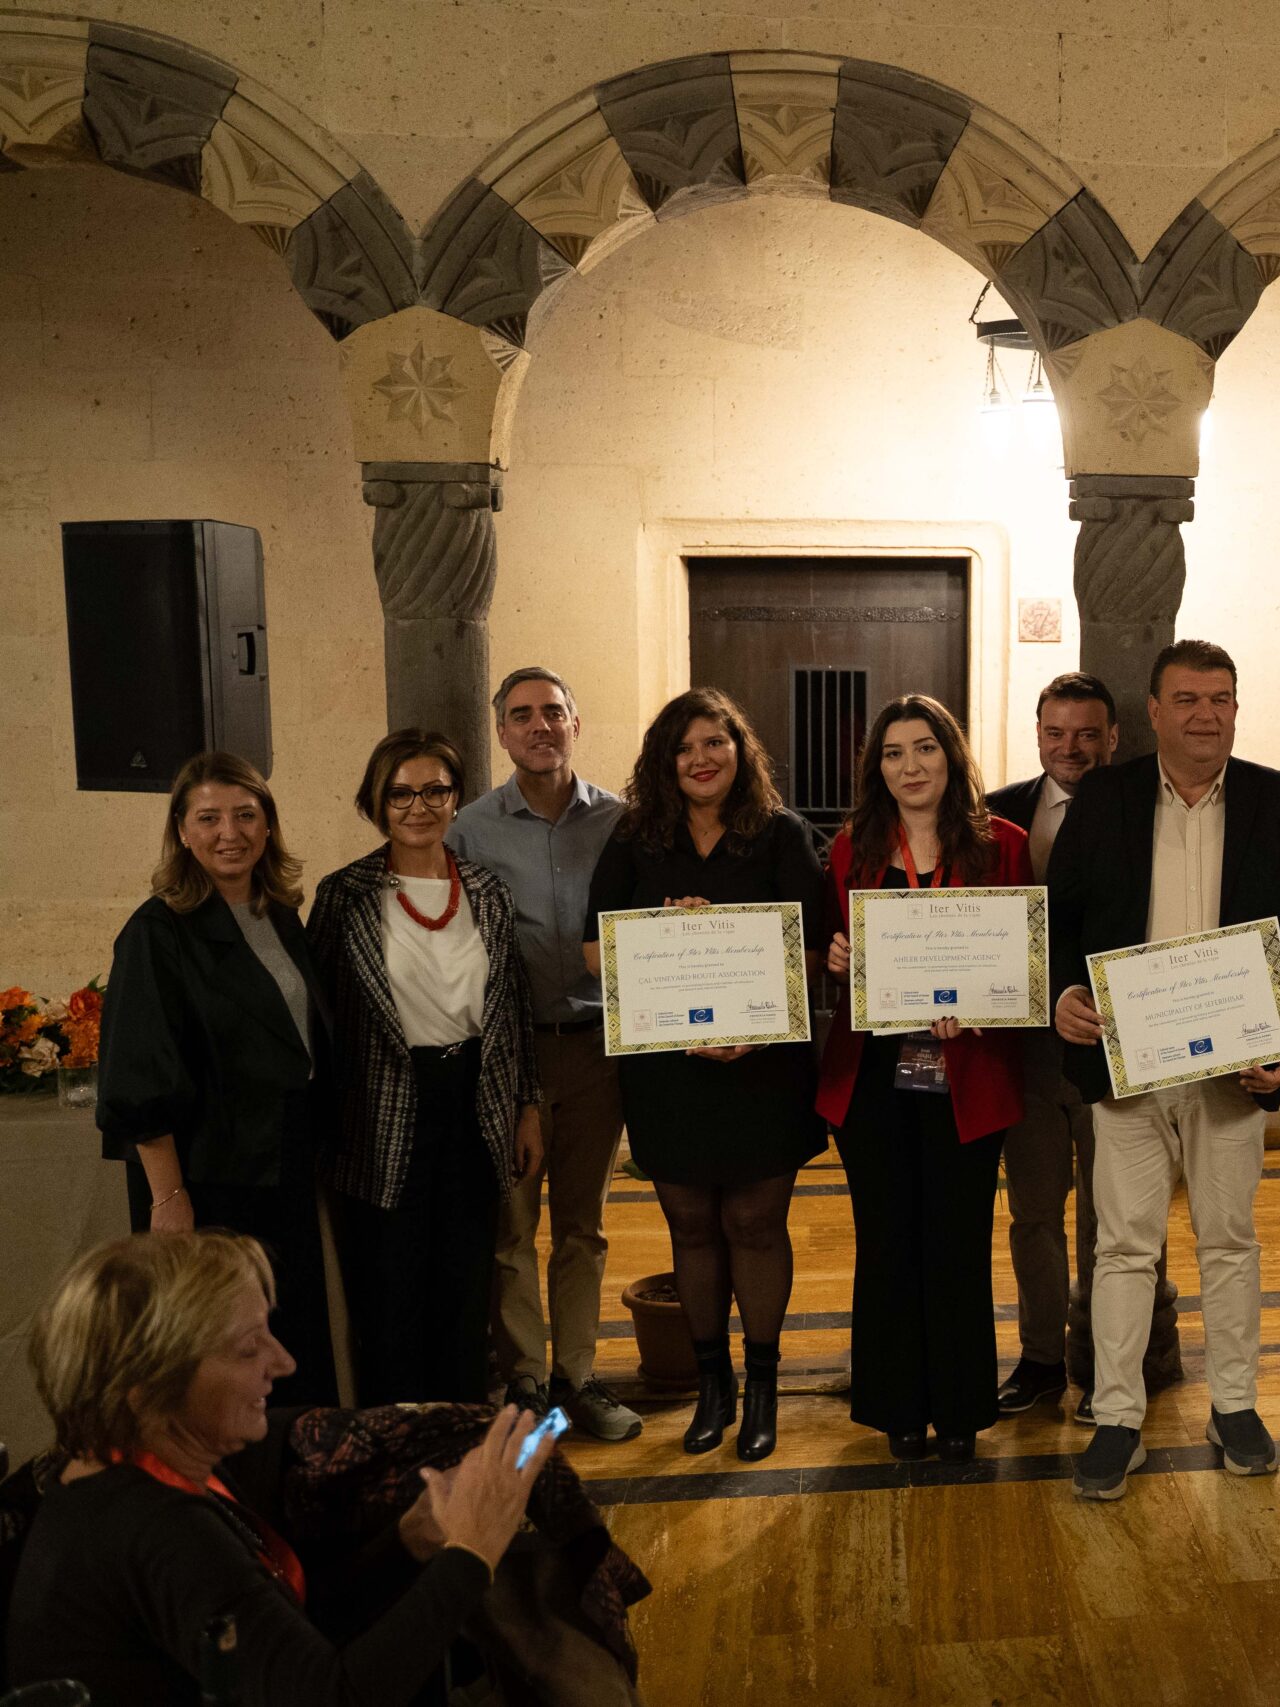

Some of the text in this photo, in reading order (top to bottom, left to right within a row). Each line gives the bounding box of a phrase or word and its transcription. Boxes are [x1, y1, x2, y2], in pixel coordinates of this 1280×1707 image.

[930, 904, 981, 913] Iter Vitis
[682, 920, 735, 931] Iter Vitis
[881, 932, 922, 942] Certification
[924, 930, 933, 941] of
[967, 929, 1009, 940] Membership
[634, 952, 674, 962] Certification
[677, 948, 686, 960] of
[722, 945, 764, 956] Membership
[1169, 947, 1218, 964] Iter Vitis
[1127, 987, 1167, 1000] Certification
[1170, 981, 1177, 994] of
[1212, 967, 1250, 981] Membership
[1145, 1004, 1192, 1021] MUNICIPALITY
